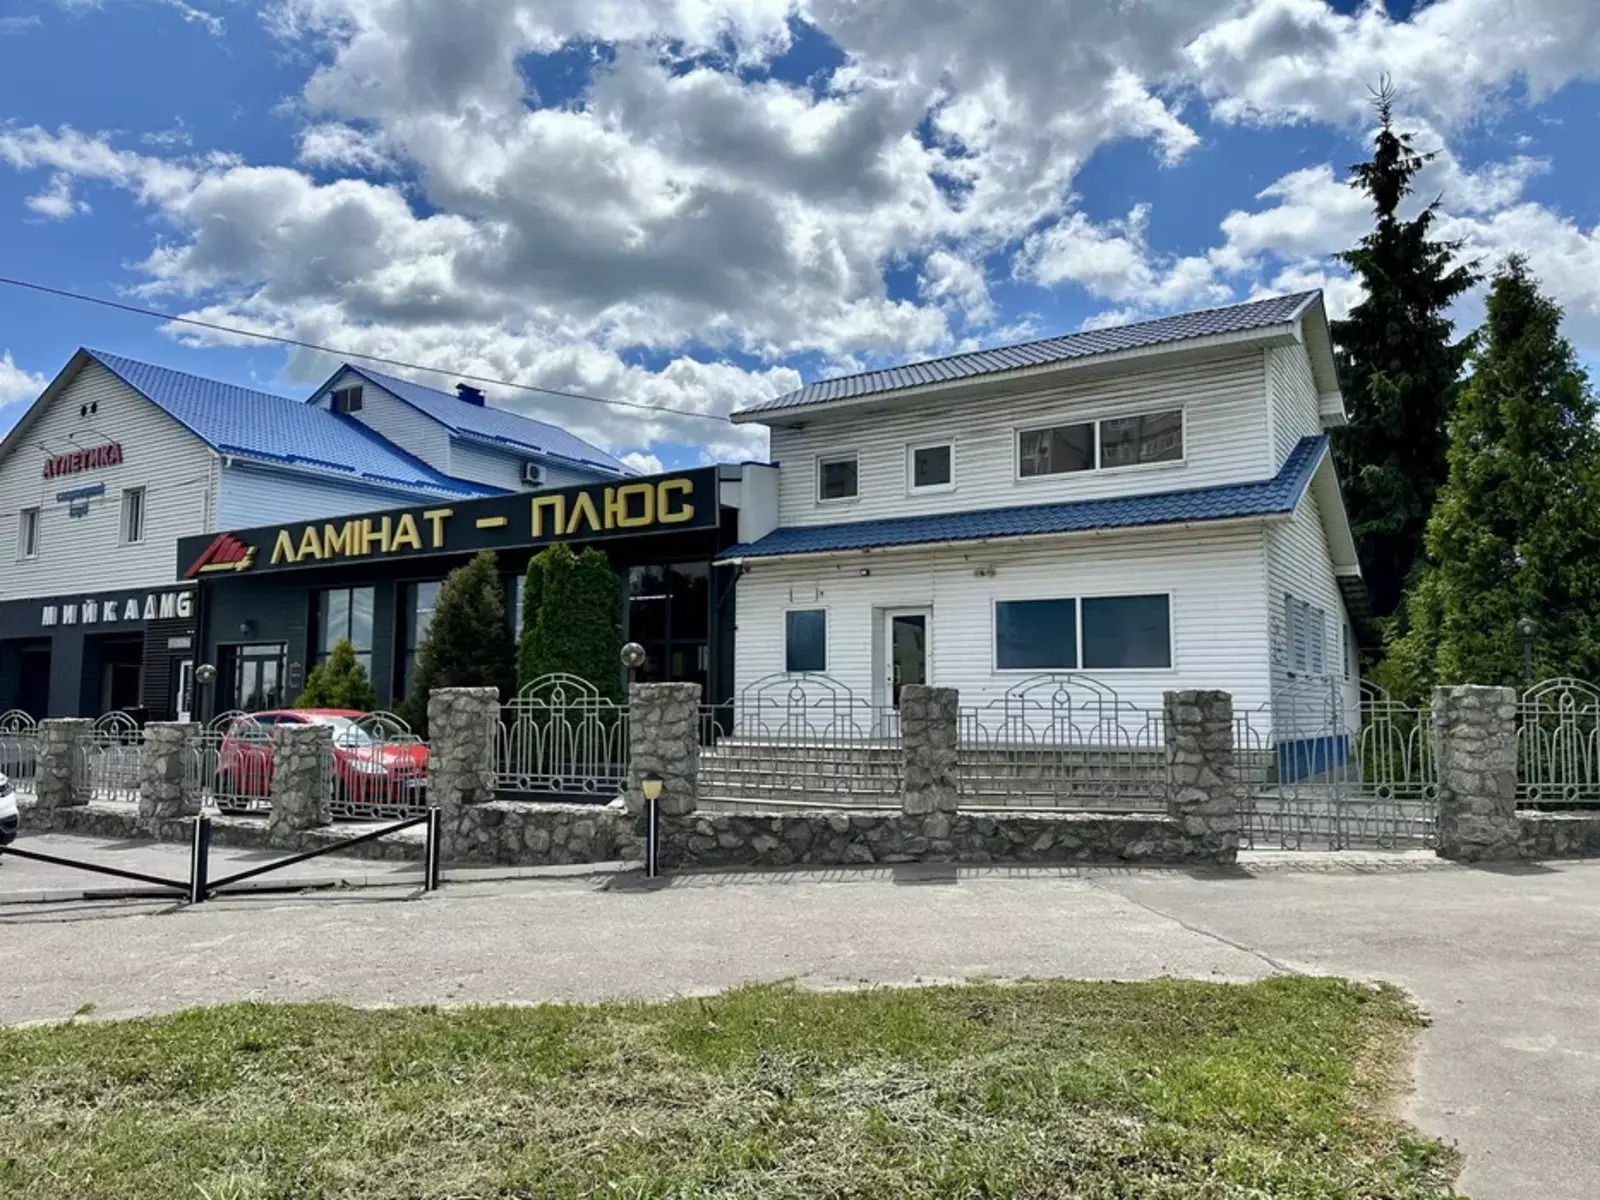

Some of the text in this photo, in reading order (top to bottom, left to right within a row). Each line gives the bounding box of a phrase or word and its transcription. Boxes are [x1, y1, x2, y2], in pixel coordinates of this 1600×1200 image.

[270, 509, 453, 564] ЛАМІНАТ
[531, 478, 694, 537] ПЛЮС
[41, 599, 140, 626] МИЙКА
